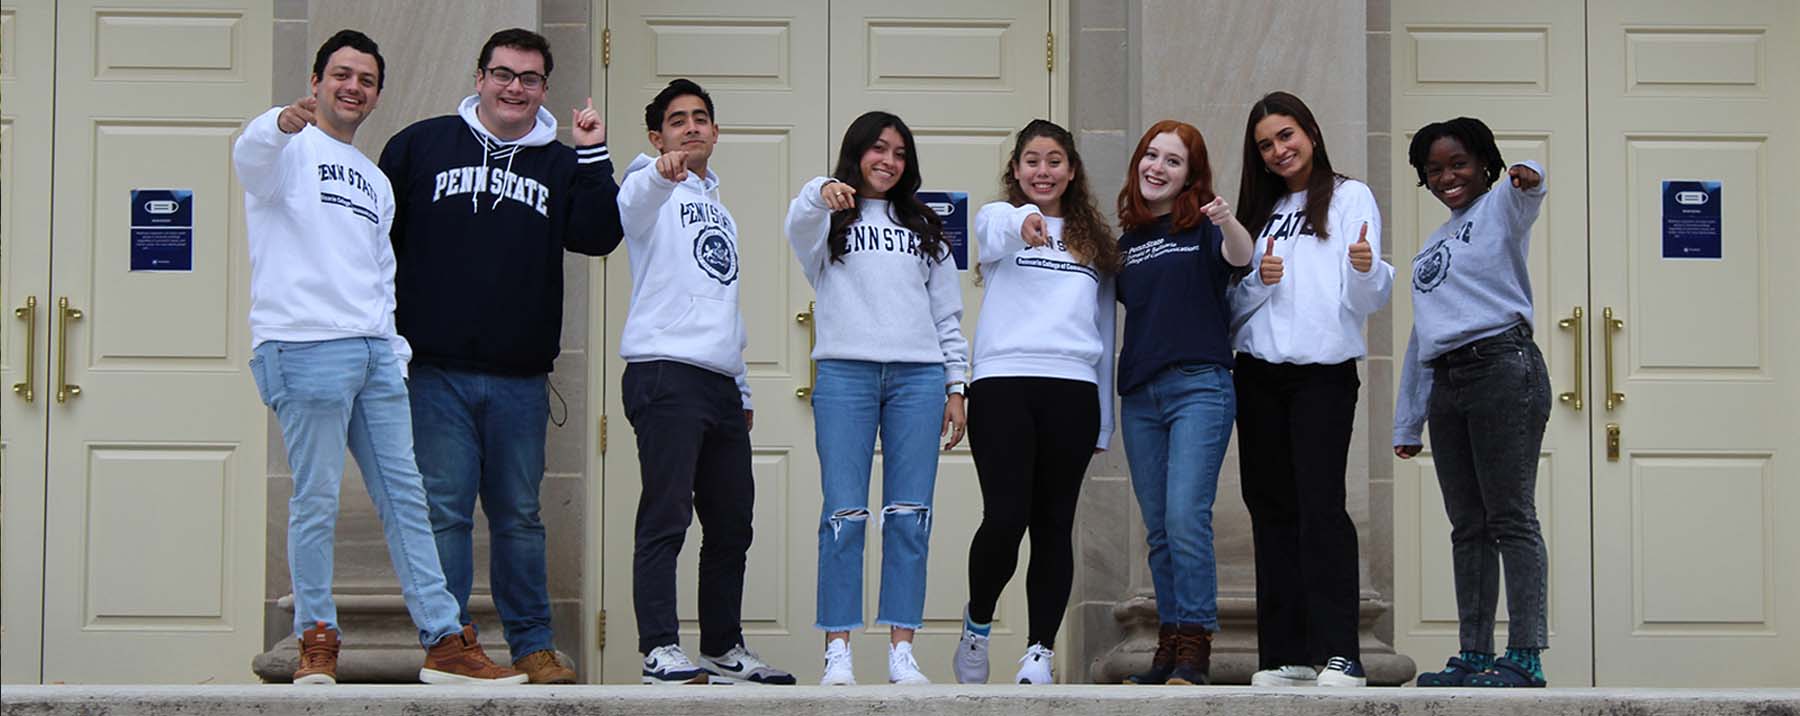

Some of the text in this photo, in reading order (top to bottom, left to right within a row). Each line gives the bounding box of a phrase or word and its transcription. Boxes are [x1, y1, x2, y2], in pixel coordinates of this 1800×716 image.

[432, 166, 549, 217] PENN STATE
[843, 224, 879, 255] ENN
[883, 227, 932, 268] STA
